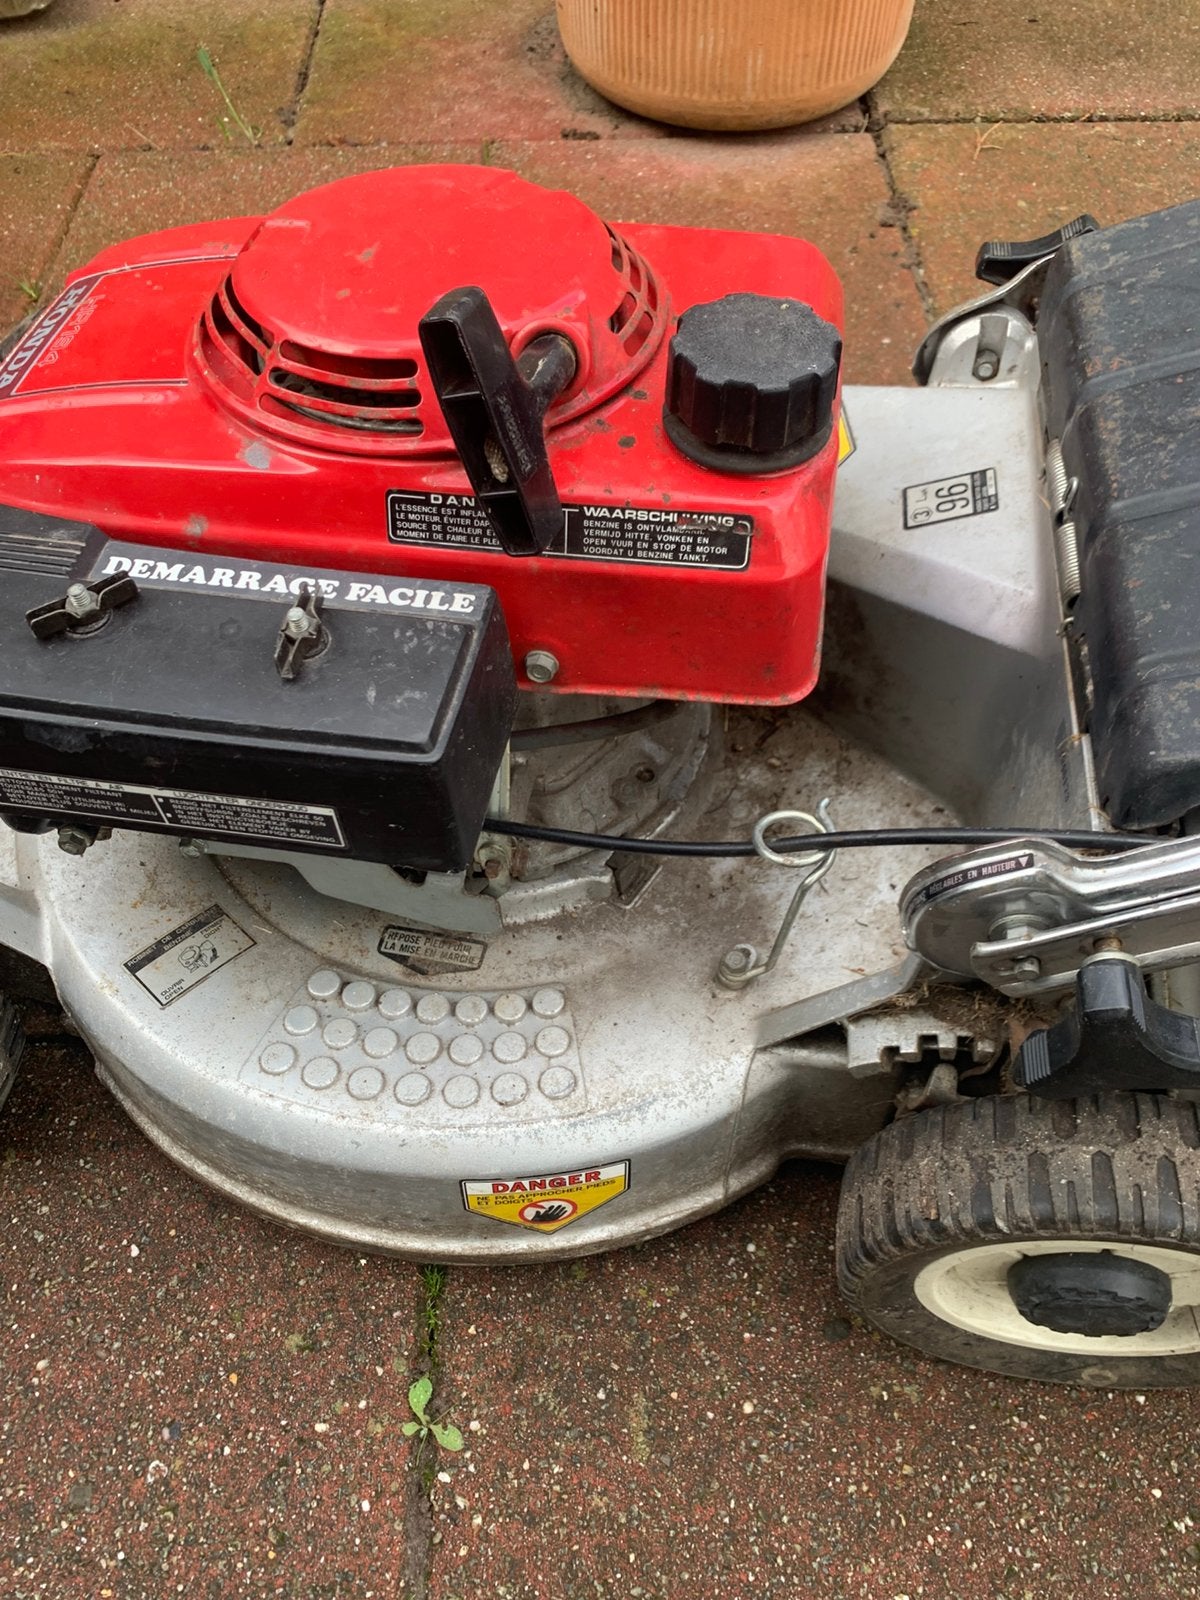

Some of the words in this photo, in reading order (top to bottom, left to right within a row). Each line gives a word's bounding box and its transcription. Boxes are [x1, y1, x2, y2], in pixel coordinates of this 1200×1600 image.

[0, 285, 88, 388] HONDA
[430, 494, 475, 507] DAN
[935, 483, 970, 513] 96
[395, 503, 438, 514] L'ESSENCE
[441, 508, 457, 516] EST
[396, 512, 406, 520] LE
[396, 521, 428, 531] SOURCE
[431, 524, 443, 532] DE
[446, 525, 483, 536] CHALEUR
[583, 519, 620, 530] BENZINE
[624, 522, 633, 530] IS
[396, 529, 430, 539] MOMENT
[433, 532, 444, 541] DE
[446, 534, 468, 543] FAIRE
[470, 536, 480, 544] LE
[583, 528, 622, 538] VERMIJD
[656, 534, 694, 544] VONKEN
[697, 536, 710, 545] EN
[583, 537, 607, 547] OPEN
[611, 539, 633, 548] VUUR
[636, 541, 649, 549] EN
[652, 542, 677, 552] STOP
[680, 544, 692, 553] DE
[696, 546, 728, 556] MOTOR
[583, 546, 624, 557] VOORDAT
[627, 549, 633, 557] U
[637, 550, 674, 560] BENZINE
[678, 553, 709, 563] TANKT.
[101, 556, 338, 600] DEMARRAGE
[345, 582, 475, 614] FACILE
[967, 870, 978, 880] EN
[981, 859, 1016, 876] HAUTEUR
[161, 934, 173, 944] DE
[386, 930, 422, 945] REPOSE
[384, 940, 396, 951] LA
[400, 944, 422, 954] MISE
[424, 948, 438, 958] EN
[440, 951, 477, 964] MARCHE
[164, 985, 185, 1001] OPEN
[492, 1170, 601, 1194] DANGER
[518, 1187, 583, 1200] APPROCHER
[586, 1180, 616, 1190] PIEDS
[494, 1198, 534, 1206] DOIGTS
